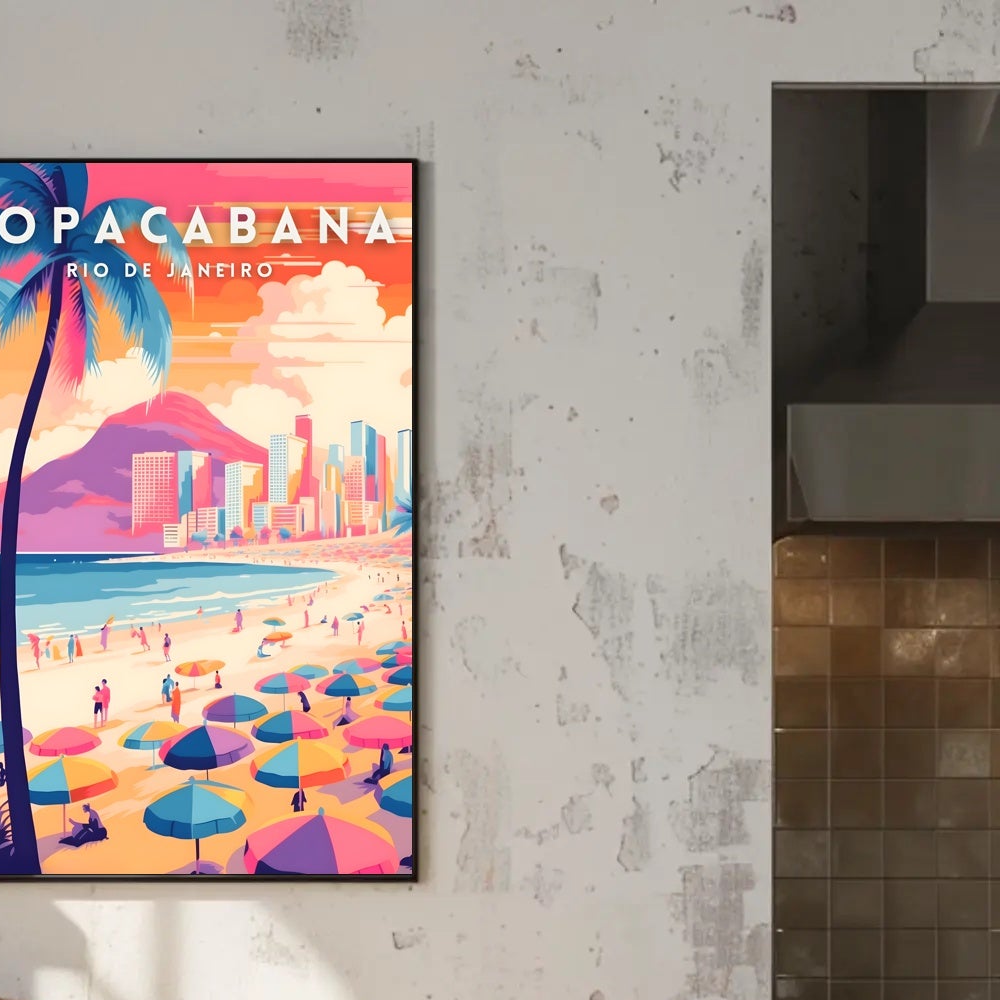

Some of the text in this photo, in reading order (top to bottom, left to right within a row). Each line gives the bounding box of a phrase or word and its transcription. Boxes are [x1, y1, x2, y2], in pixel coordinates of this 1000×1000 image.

[66, 262, 274, 279] RIO DE JANEIRO
